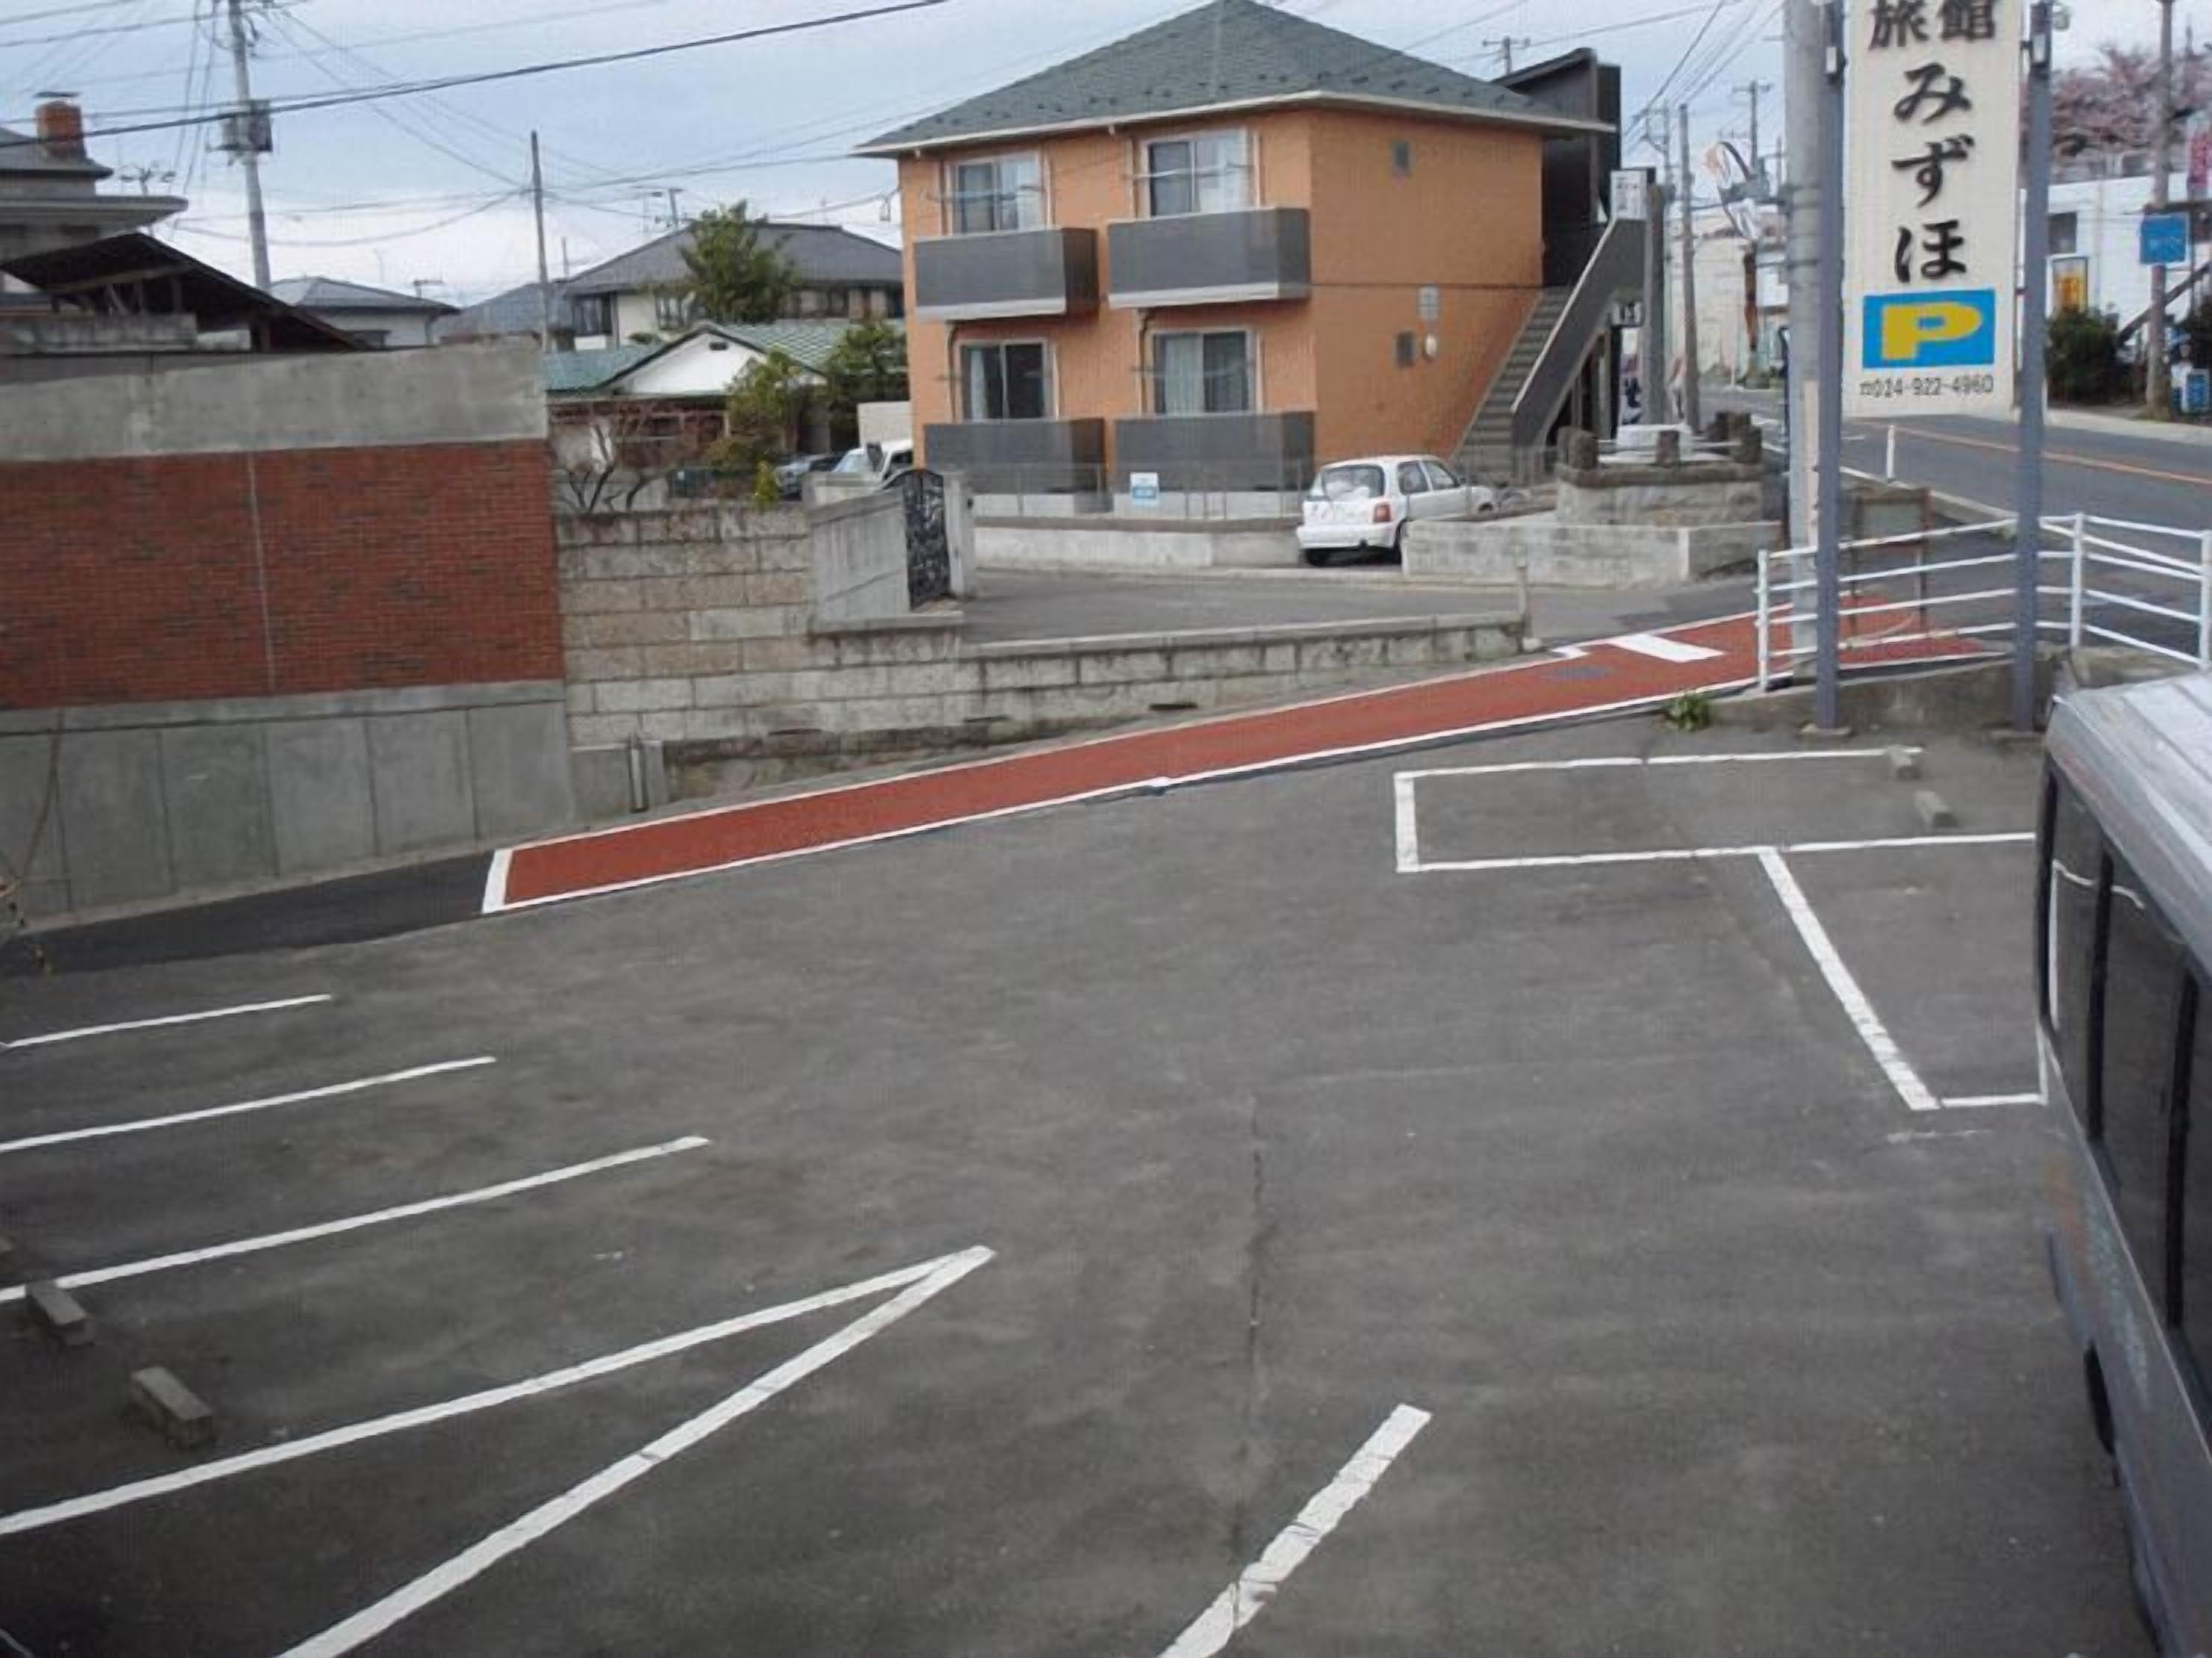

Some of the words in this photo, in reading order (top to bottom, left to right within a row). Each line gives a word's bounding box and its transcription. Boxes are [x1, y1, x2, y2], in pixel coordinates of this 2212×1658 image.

[1868, 0, 1997, 50] 旅館
[1889, 62, 1975, 283] みずほ
[1881, 302, 1983, 360] P
